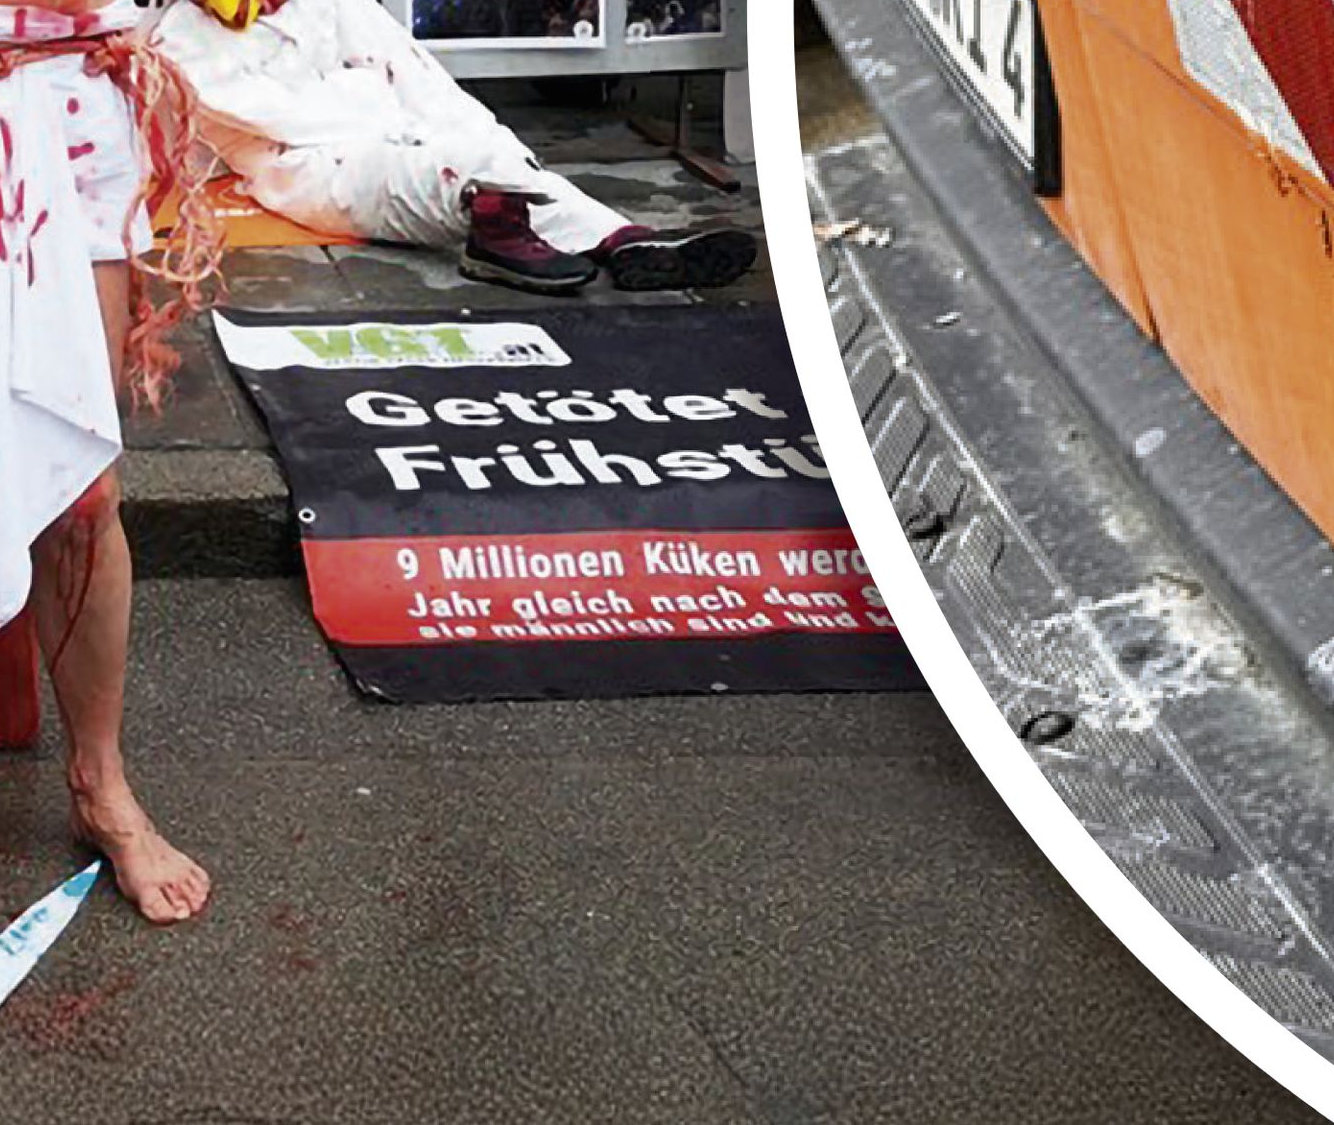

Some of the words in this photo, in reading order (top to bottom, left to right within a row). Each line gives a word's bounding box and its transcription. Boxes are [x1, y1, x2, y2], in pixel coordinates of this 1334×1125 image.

[346, 388, 788, 427] Getötet
[397, 548, 419, 579] 9
[438, 546, 624, 580] Millionen
[643, 541, 760, 577] Küken
[407, 591, 492, 619] Jahr
[512, 586, 633, 621] gleich
[650, 585, 747, 611] nach
[764, 584, 848, 610] dem
